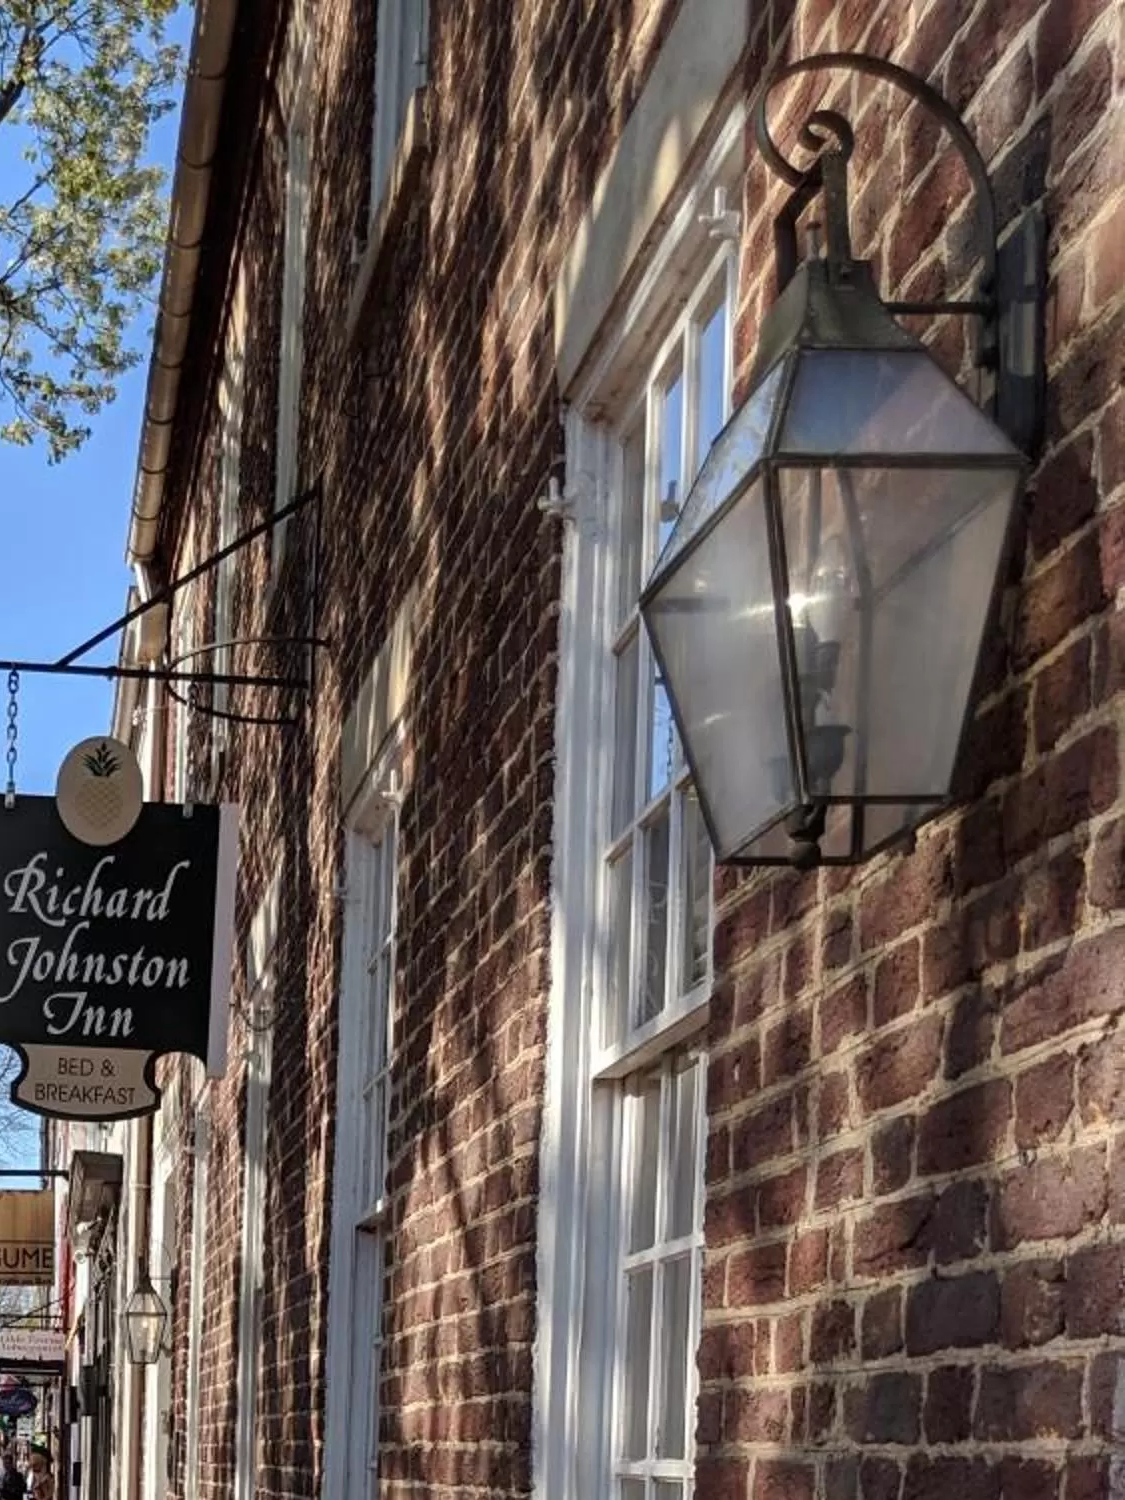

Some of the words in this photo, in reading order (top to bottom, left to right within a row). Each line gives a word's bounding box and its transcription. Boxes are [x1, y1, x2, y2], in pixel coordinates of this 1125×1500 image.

[3, 851, 191, 927] Richard
[42, 991, 136, 1038] Inn
[57, 1056, 95, 1076] BED
[99, 1058, 116, 1077] &
[34, 1083, 136, 1105] BREAKFAST
